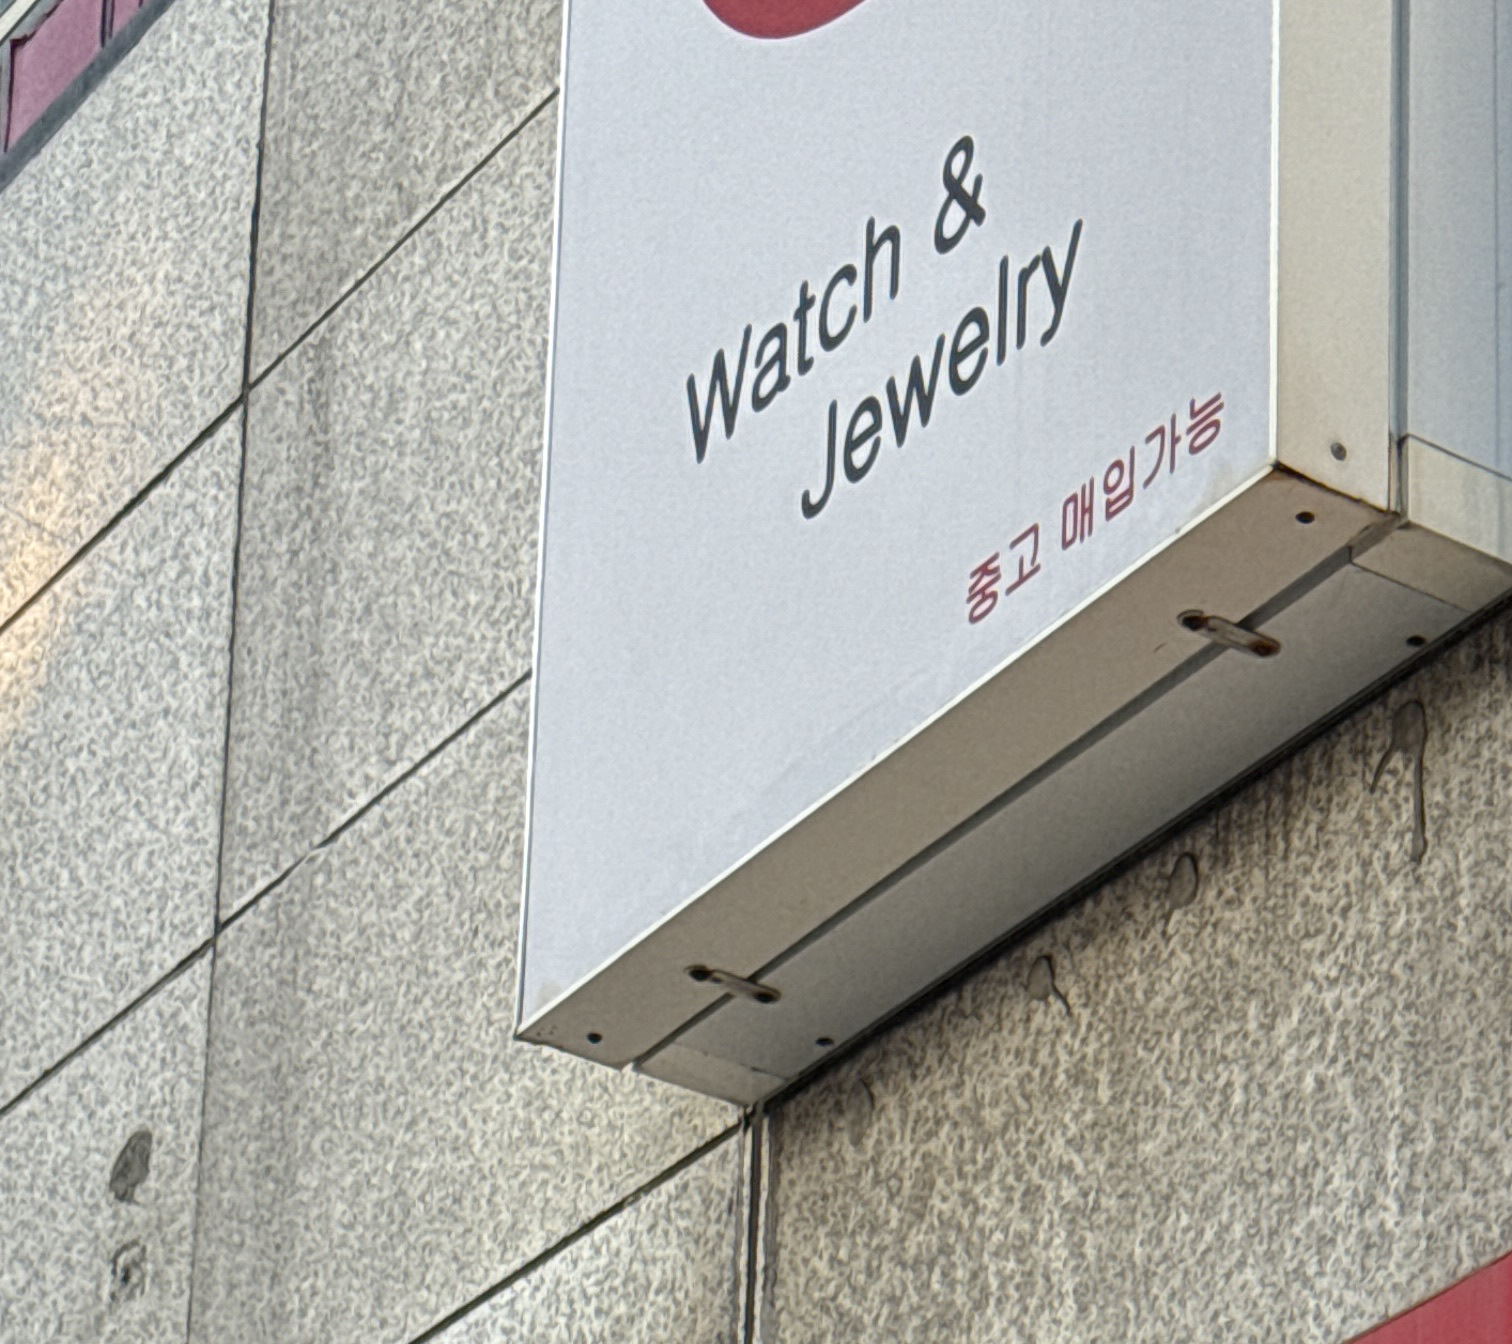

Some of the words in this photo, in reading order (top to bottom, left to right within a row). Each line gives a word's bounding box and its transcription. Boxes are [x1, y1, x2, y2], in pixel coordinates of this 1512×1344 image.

[686, 216, 900, 464] Watch
[933, 134, 986, 255] &
[801, 218, 1083, 520] Jewelry
[966, 522, 1041, 625] 중고
[1061, 391, 1225, 552] 매입가능
